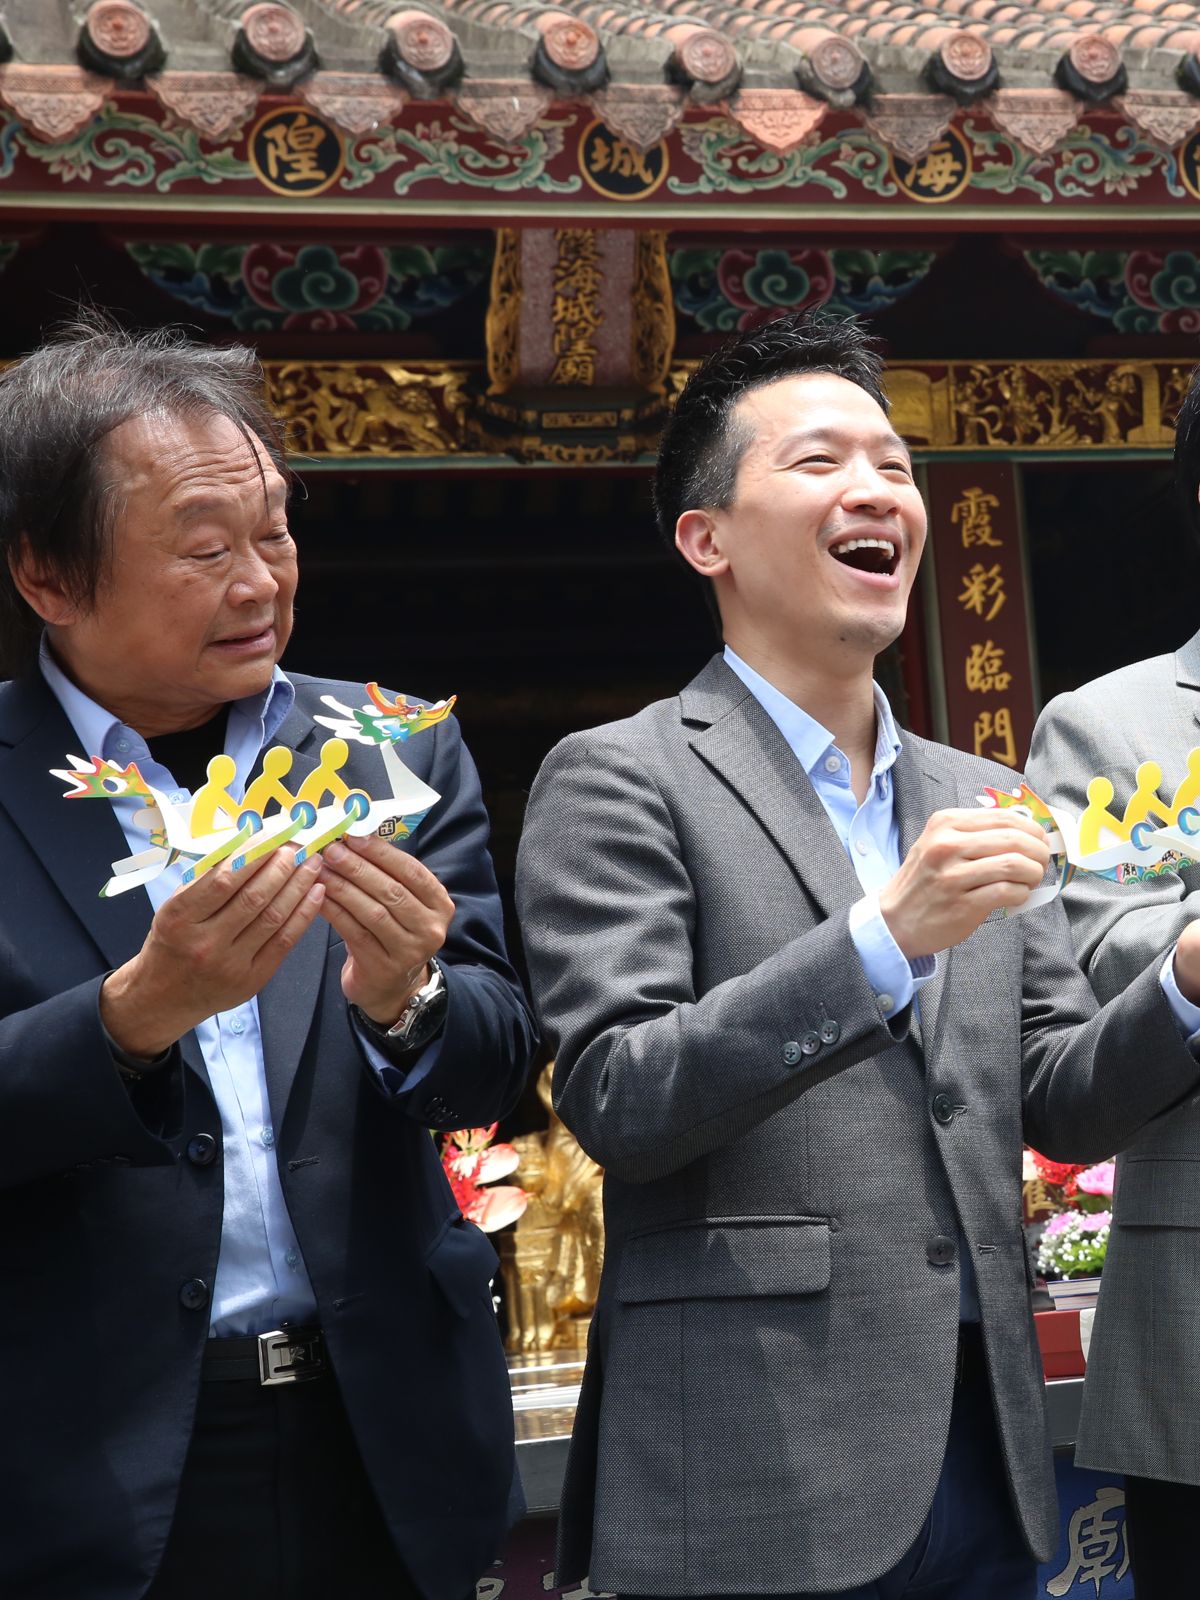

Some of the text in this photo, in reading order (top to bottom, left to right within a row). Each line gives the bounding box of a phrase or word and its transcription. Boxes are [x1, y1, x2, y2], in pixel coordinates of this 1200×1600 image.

[263, 113, 327, 183] 隍
[951, 487, 1017, 768] 霞彩臨門
